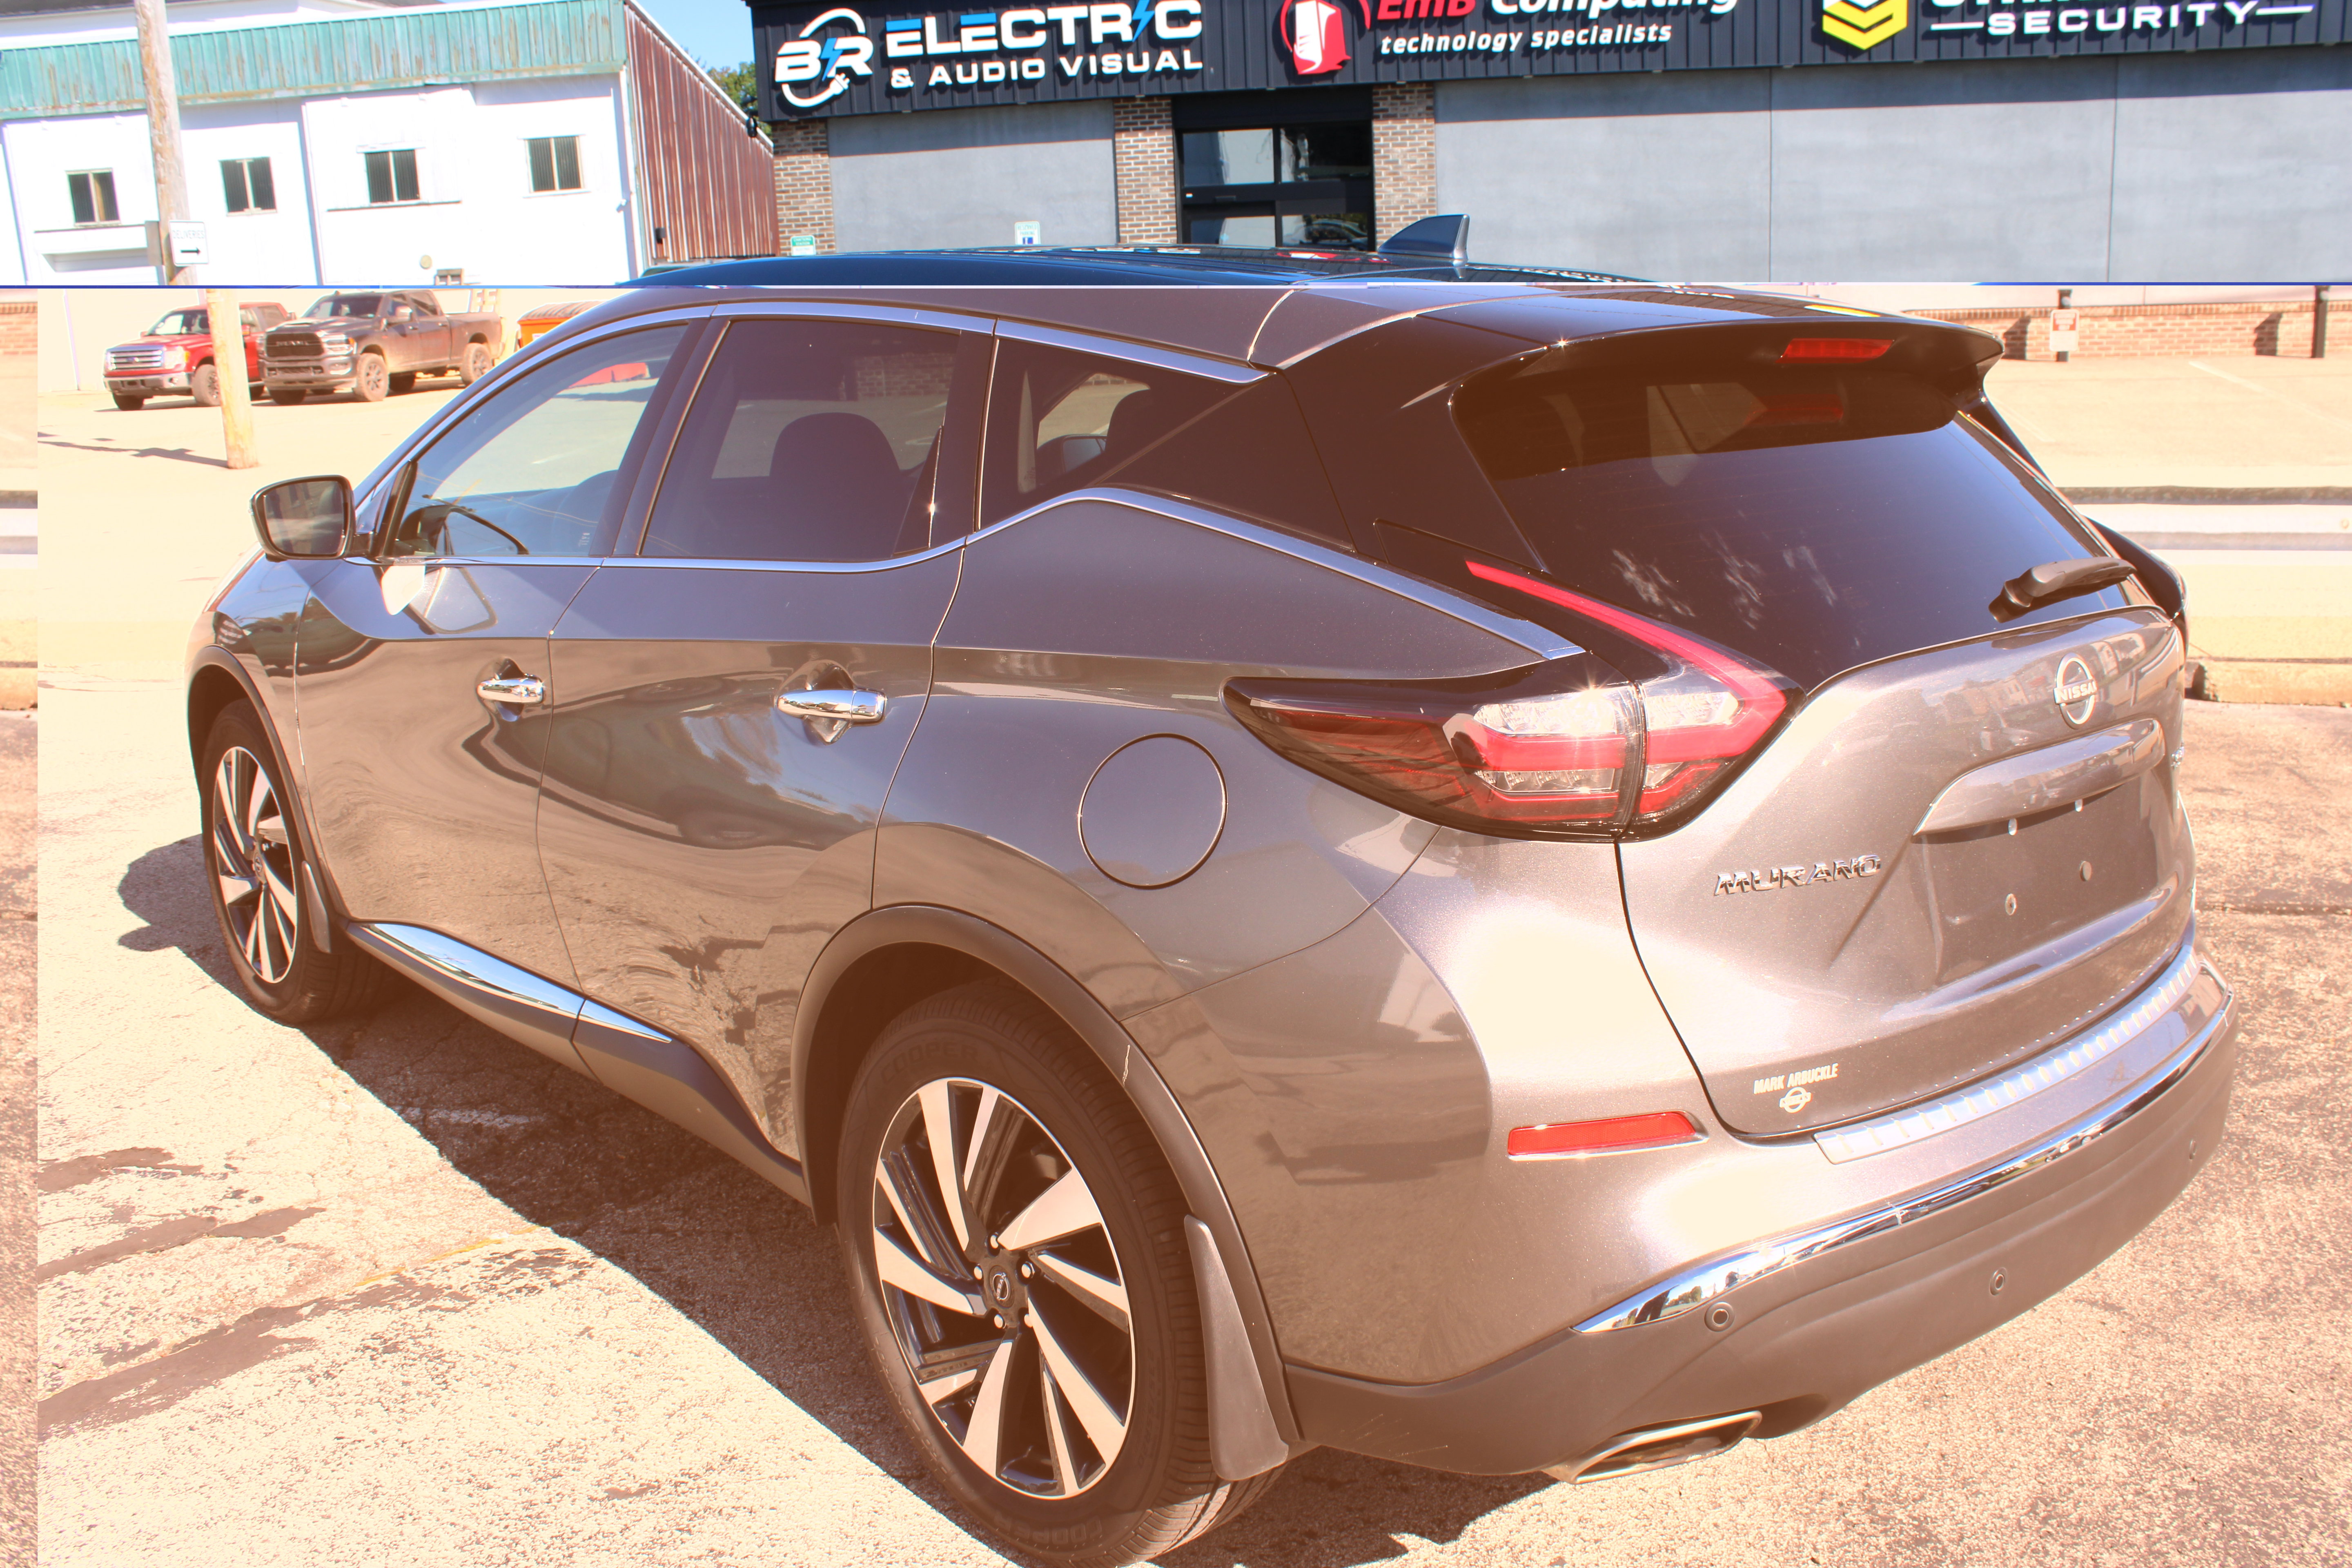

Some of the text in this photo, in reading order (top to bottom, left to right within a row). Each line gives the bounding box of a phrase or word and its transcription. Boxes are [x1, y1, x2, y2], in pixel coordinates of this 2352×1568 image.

[1988, 0, 2259, 35] SECURITY
[1381, 23, 1672, 55] technology specialists
[891, 49, 1203, 89] & AUDIO VISUAL
[2054, 680, 2097, 704] NISSAN
[1714, 854, 1882, 896] MURANO
[880, 1040, 978, 1085] COOPER
[1754, 1062, 1839, 1094] MARK ARBUCKLE
